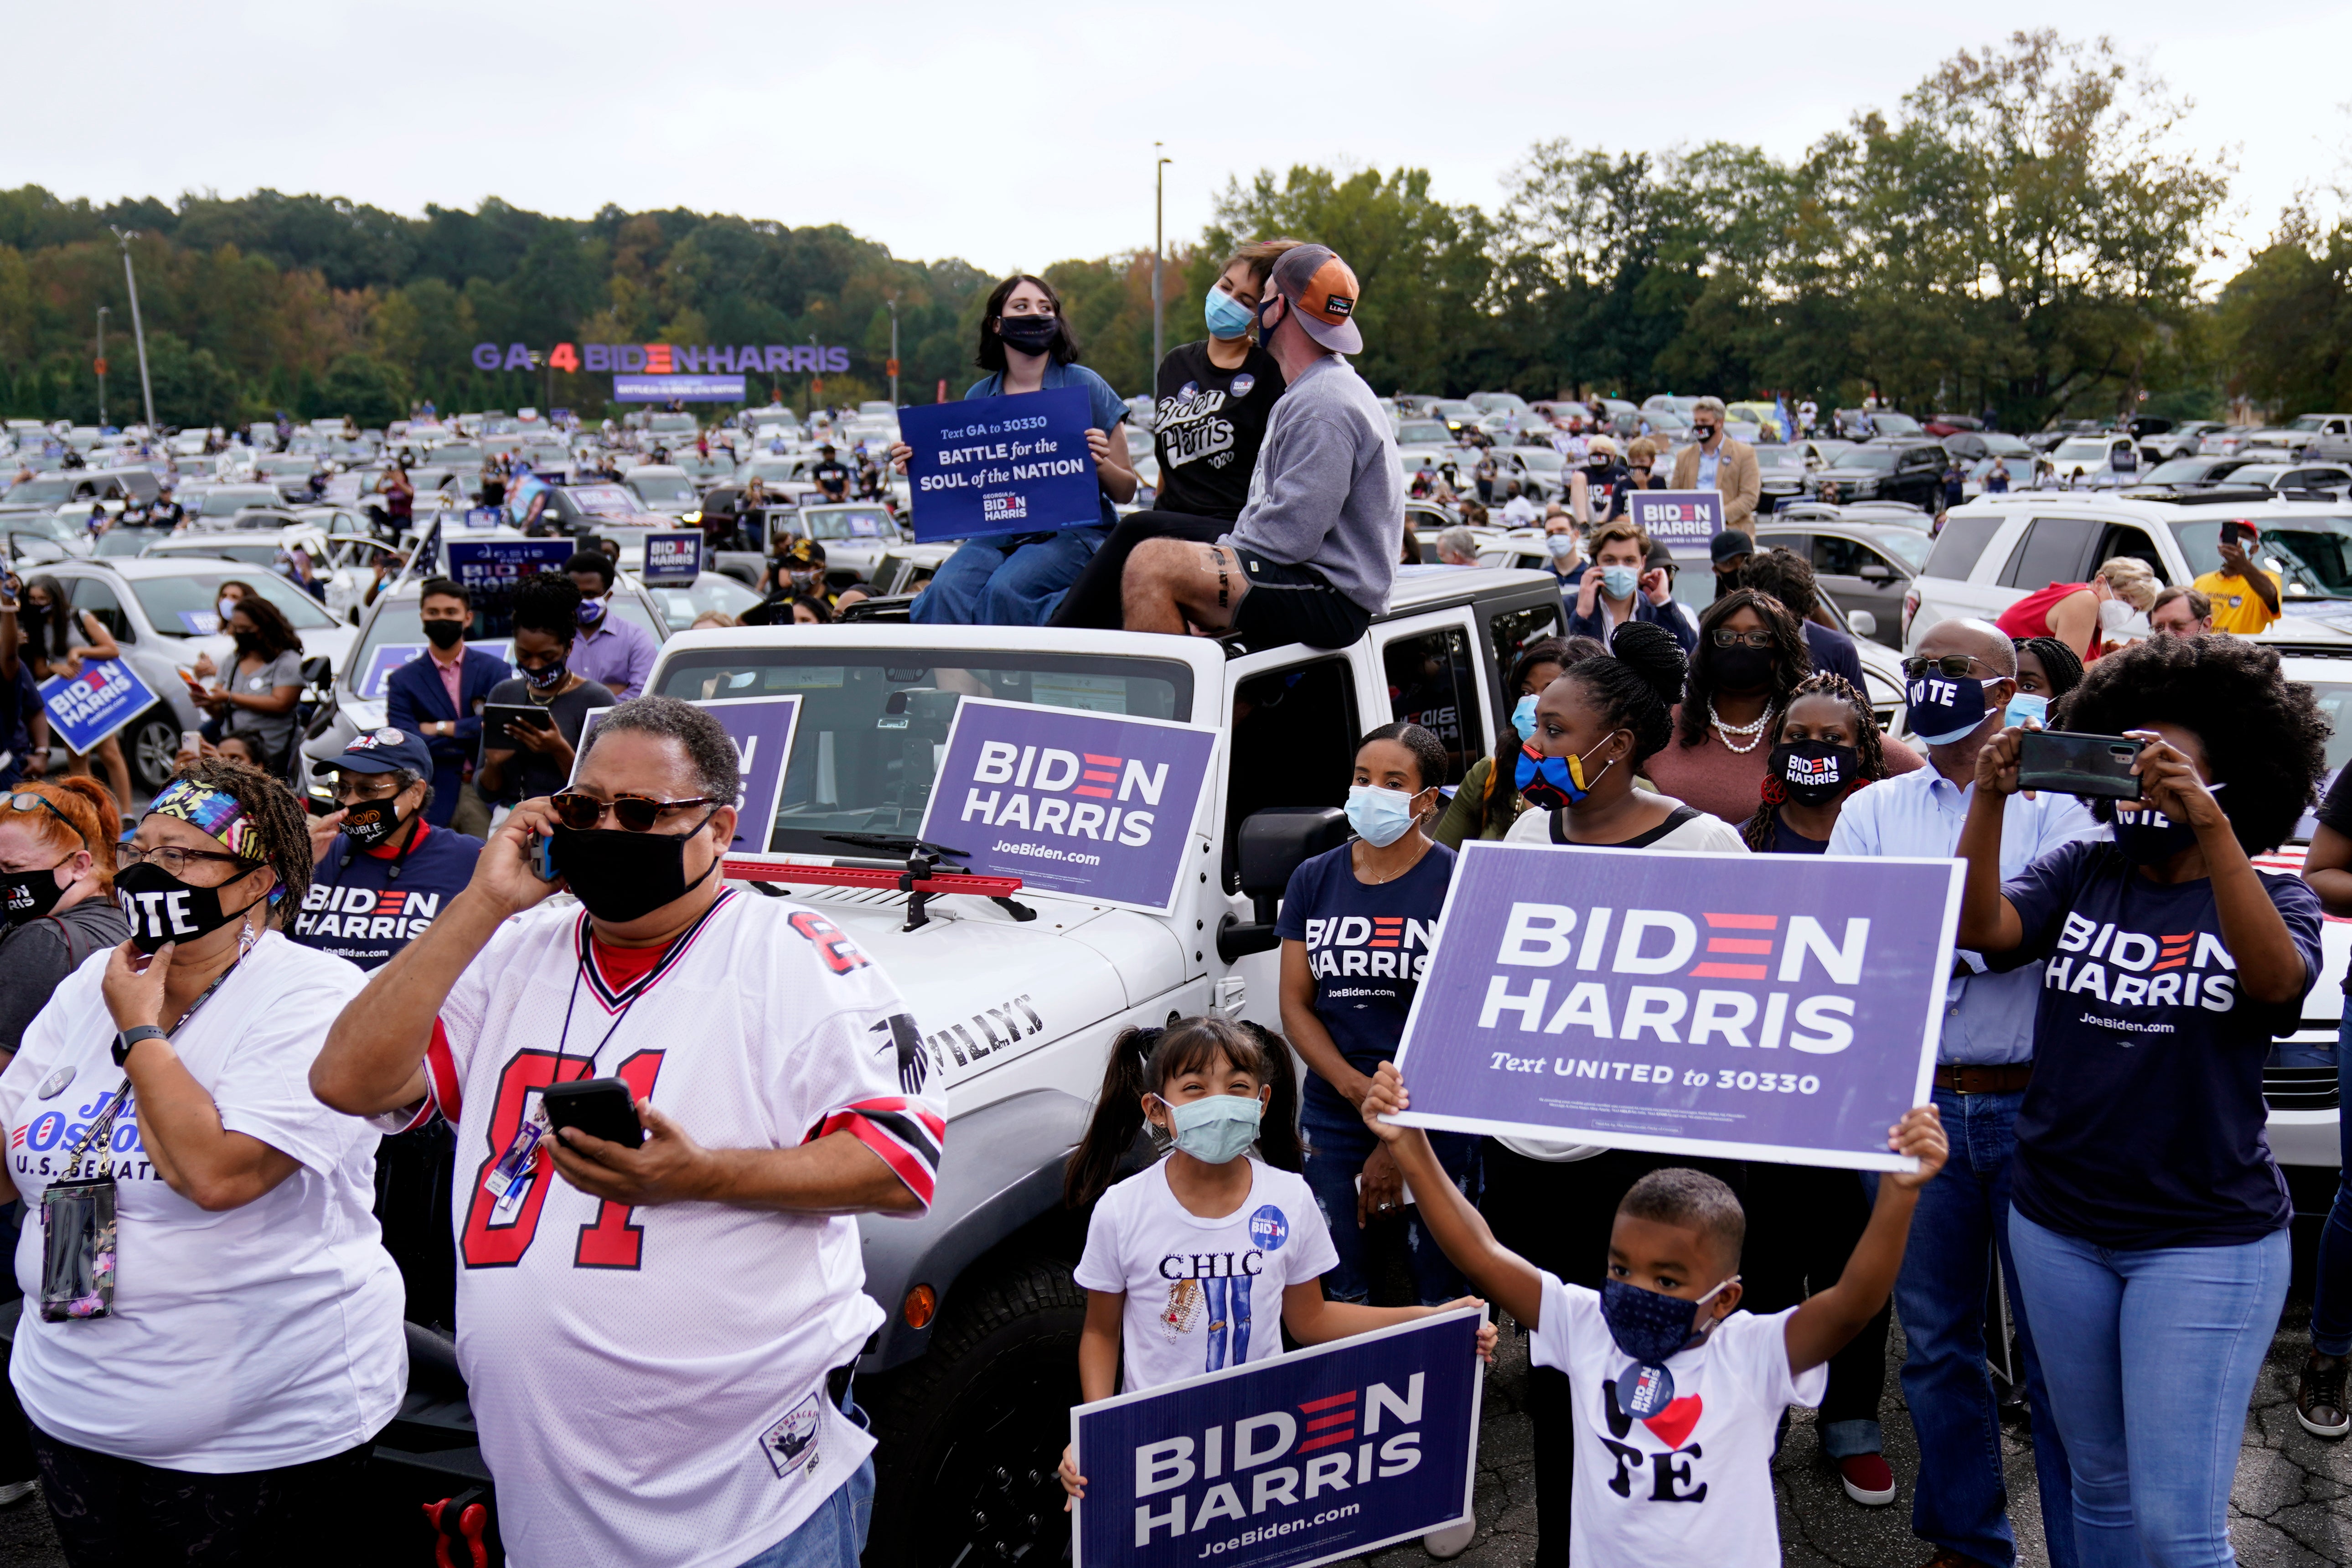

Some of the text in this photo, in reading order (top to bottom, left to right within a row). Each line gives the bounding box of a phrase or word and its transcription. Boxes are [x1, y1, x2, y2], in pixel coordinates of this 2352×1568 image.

[472, 342, 535, 371] GA
[549, 342, 580, 373] 4
[1154, 390, 1226, 434] Biden
[941, 416, 1047, 440] Text GA to 30330
[1162, 416, 1235, 469] Harris
[938, 438, 1058, 466] BATTLE for the
[920, 458, 1084, 492] SOUL of the NATION
[982, 492, 1008, 500] GEORGIA
[983, 496, 1026, 512] BIDEN
[984, 507, 1027, 521] HARRIS
[1643, 504, 1711, 521] BIDEN
[1644, 521, 1712, 536] HARRIS
[649, 554, 695, 566] HARRIS
[650, 540, 695, 555] BIDEN
[2206, 591, 2230, 600] GEORGI
[47, 660, 121, 716] BIDEN
[61, 674, 132, 728] HARRIS
[1909, 678, 1958, 707] VOTE
[973, 740, 1169, 806] BIDEN
[1786, 768, 1839, 786] HARRIS
[1788, 755, 1838, 773] BIDEN
[342, 809, 381, 825] OOD
[961, 788, 1154, 847] HARRIS
[992, 839, 1100, 866] JoeBiden.com
[116, 887, 199, 938] VOTE
[301, 884, 439, 918] BIDEN
[295, 913, 432, 940] HARRIS
[1306, 916, 1437, 952] BIDEN
[2057, 911, 2238, 972] BIDEN
[323, 946, 389, 958] JoeBiden.com
[1496, 902, 1870, 985] BIDEN
[1308, 950, 1427, 981] HARRIS
[1328, 988, 1396, 998] JoeBiden.com
[2046, 956, 2237, 1012] HARRIS
[1477, 975, 1856, 1055] HARRIS
[2079, 1013, 2175, 1033] JoeBiden.com
[1490, 1051, 1820, 1095] Text UNITED to 30330
[26, 1111, 146, 1153] Oso
[16, 1155, 165, 1181] U.S. SEAT
[459, 1048, 667, 1271] 81
[1251, 1221, 1285, 1237] BIDEN
[1158, 1249, 1263, 1280] CHIC
[1631, 1366, 1652, 1412] BIDEN
[1640, 1369, 1660, 1413] HARRIS
[768, 1410, 817, 1449] THROWBACKS
[1136, 1372, 1425, 1499] BIDEN
[806, 1453, 819, 1475] 1983
[1597, 1442, 1707, 1503] TE
[1135, 1432, 1422, 1548] HARRIS
[1199, 1501, 1360, 1558] JoeBiden.com
